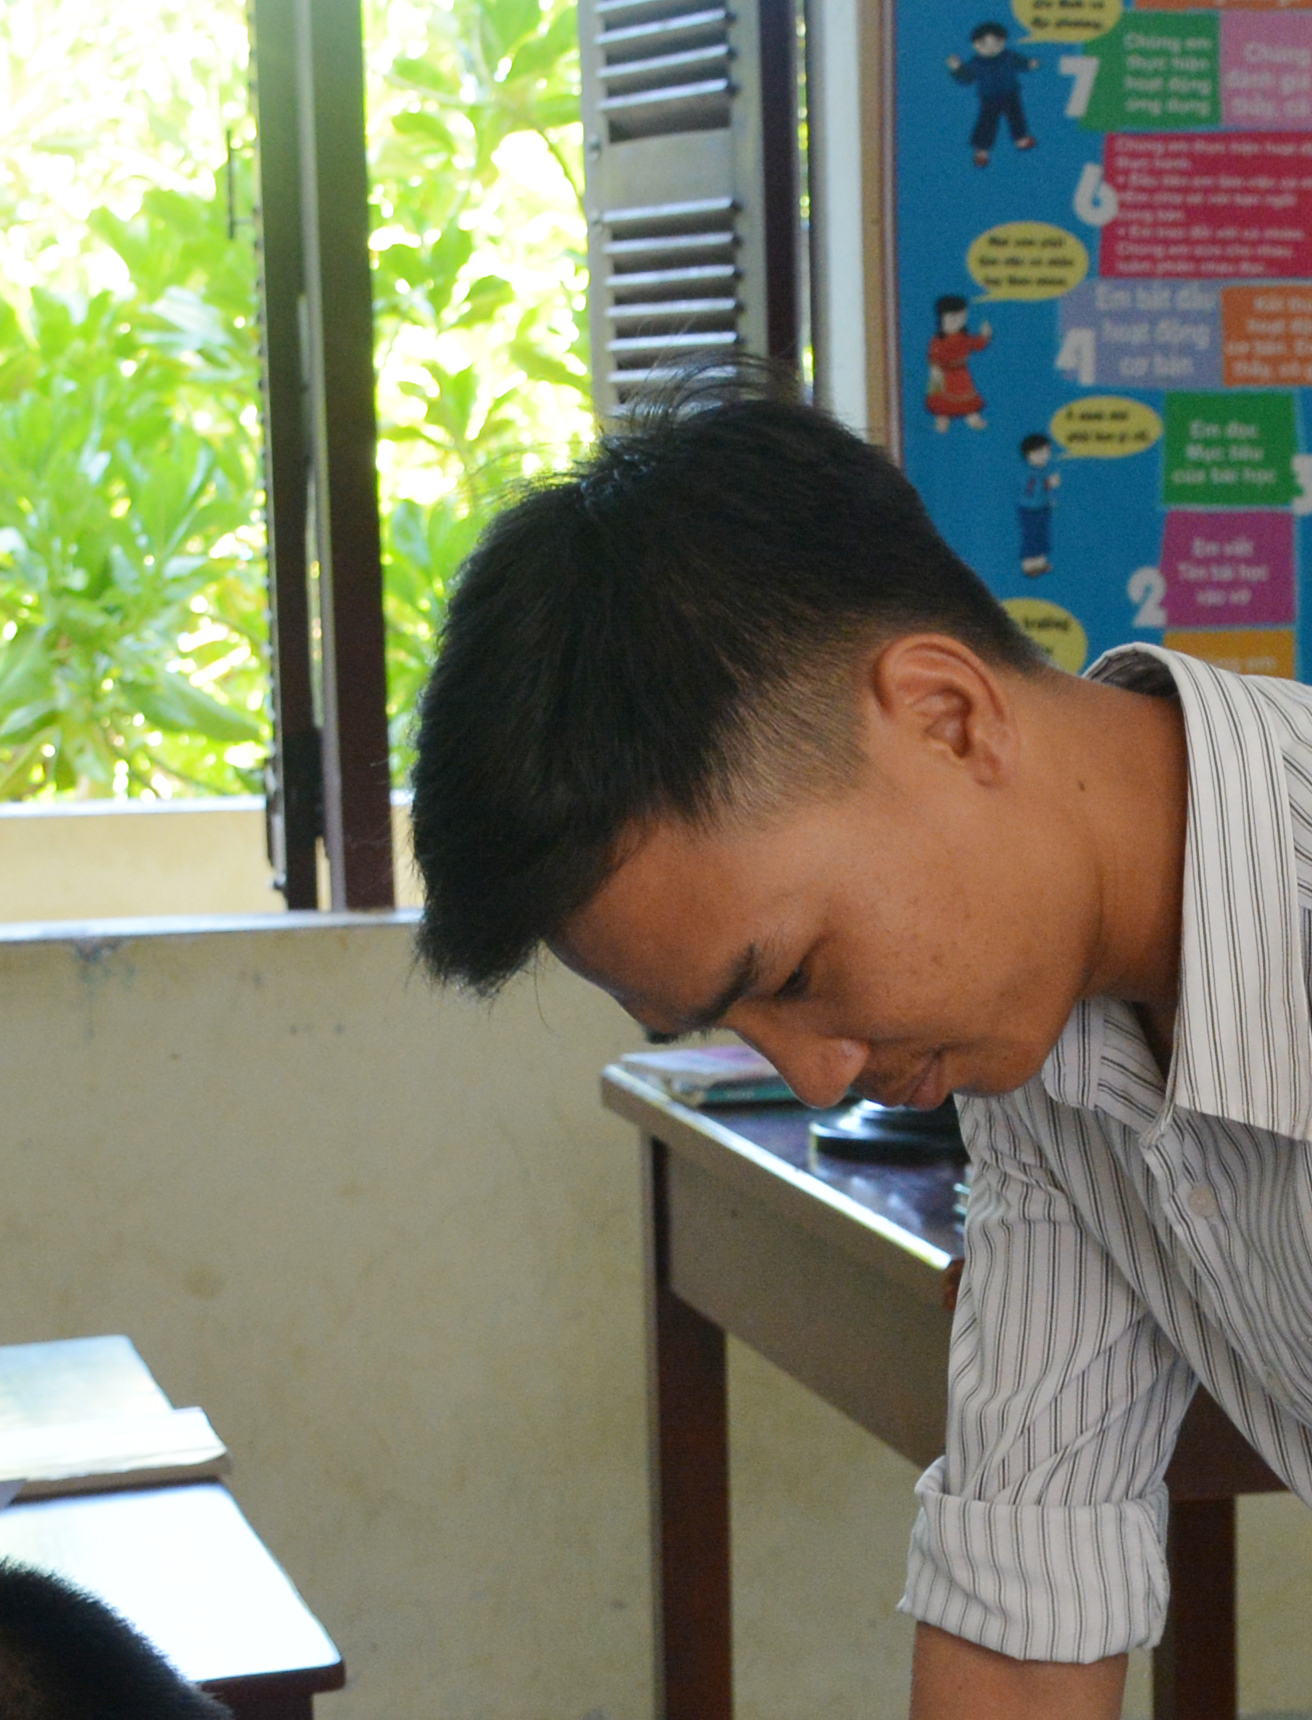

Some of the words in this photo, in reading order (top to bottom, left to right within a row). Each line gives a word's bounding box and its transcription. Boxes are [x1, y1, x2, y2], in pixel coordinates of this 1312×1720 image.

[1058, 56, 1100, 118] 7
[1073, 162, 1118, 227] 6
[1056, 328, 1096, 386] 4
[1127, 565, 1167, 628] 2
